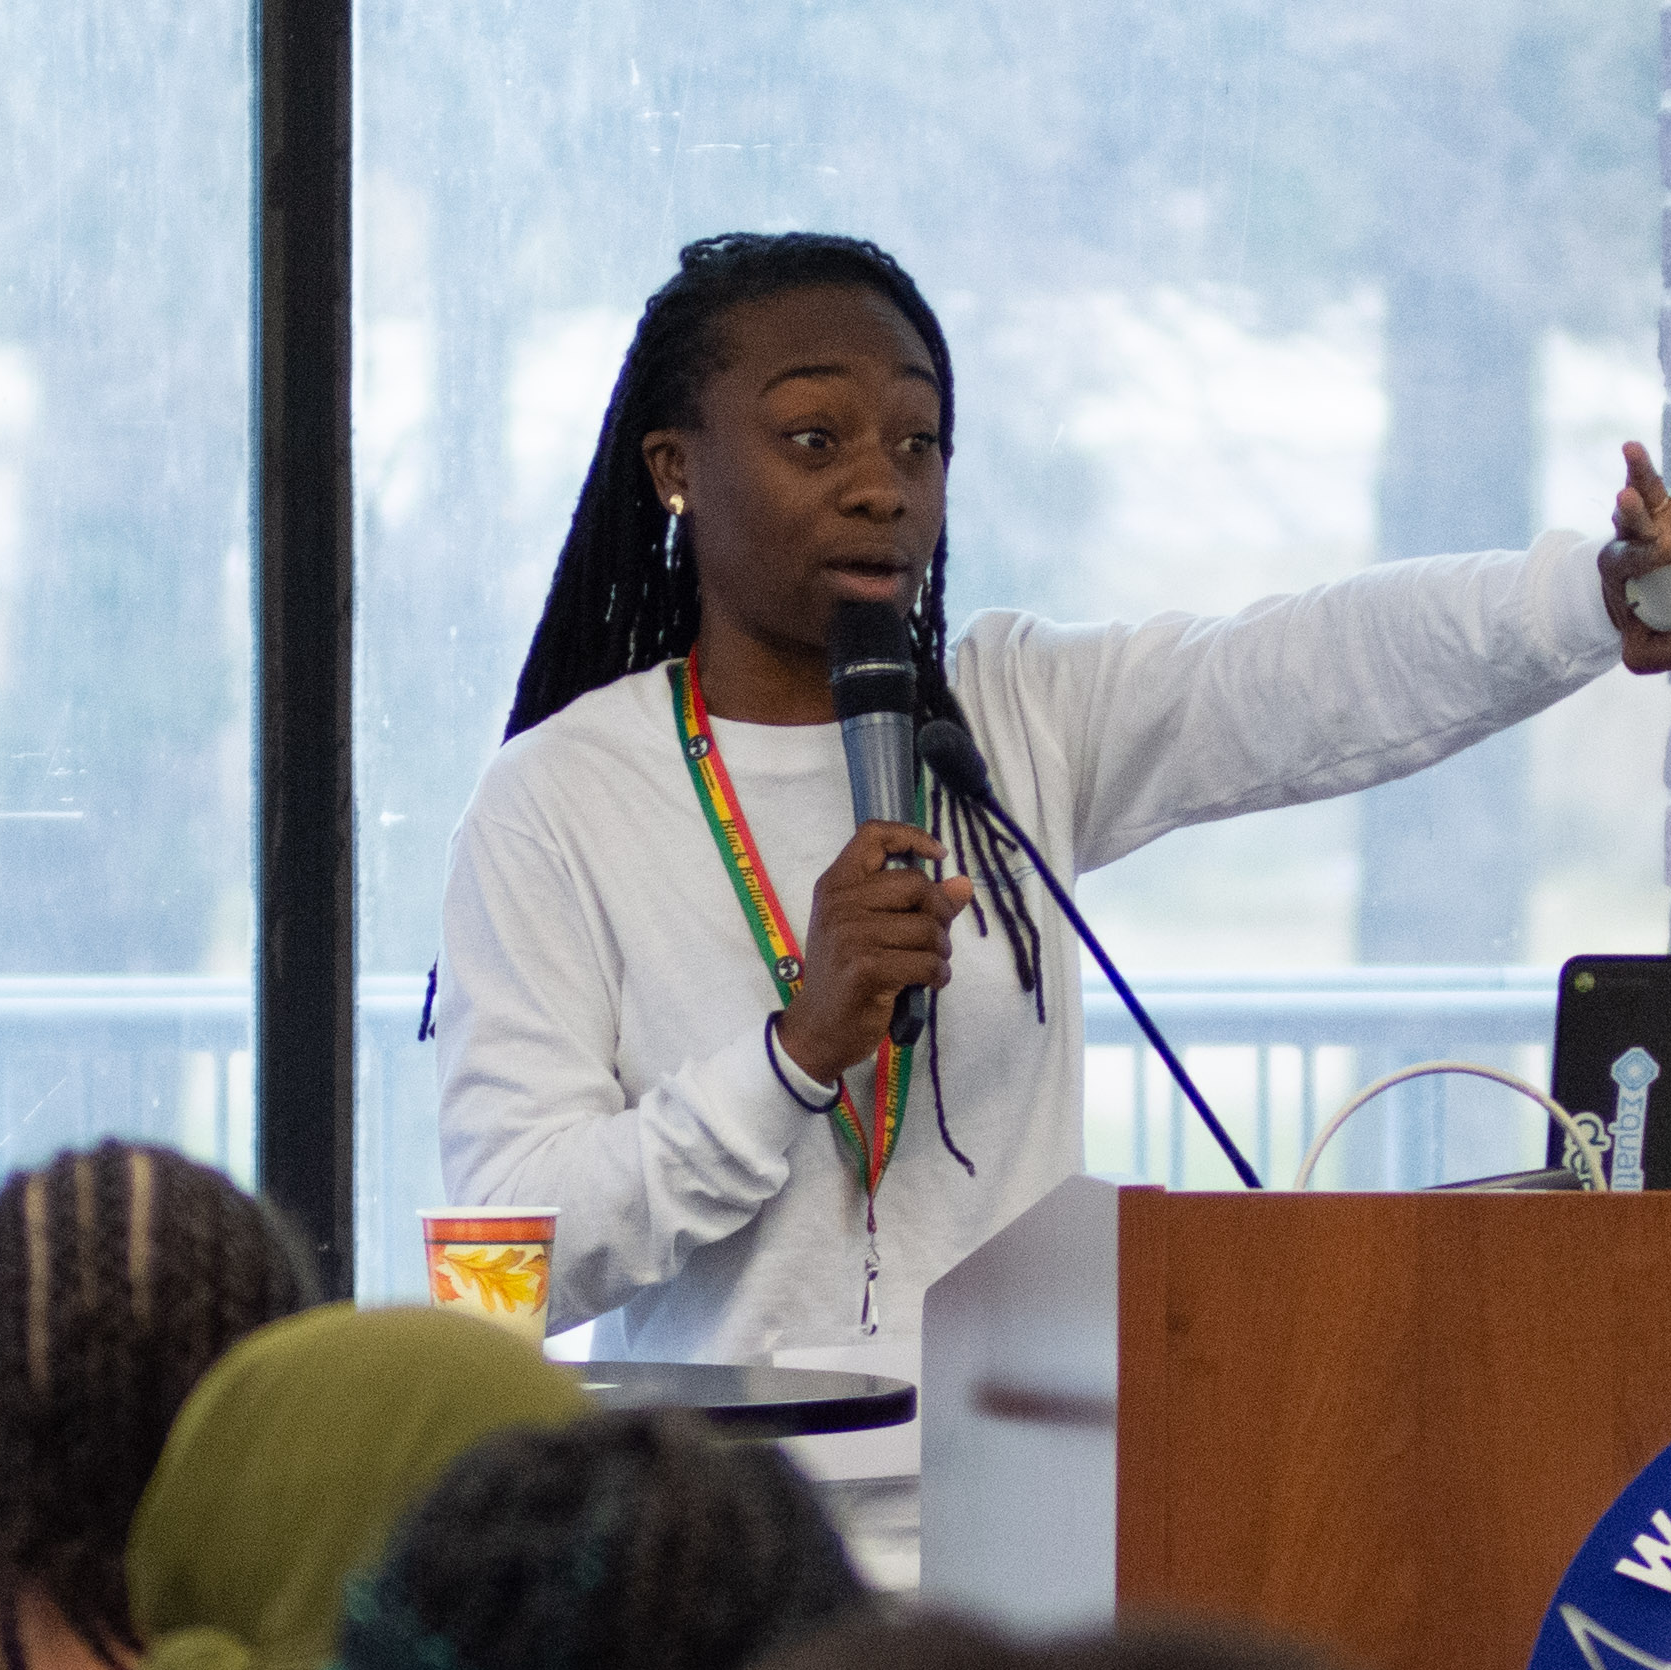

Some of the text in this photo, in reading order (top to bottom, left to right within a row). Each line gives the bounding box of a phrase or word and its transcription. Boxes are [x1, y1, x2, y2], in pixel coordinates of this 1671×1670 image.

[721, 818, 778, 939] Black Brilliance
[885, 1044, 902, 1118] Brillianc
